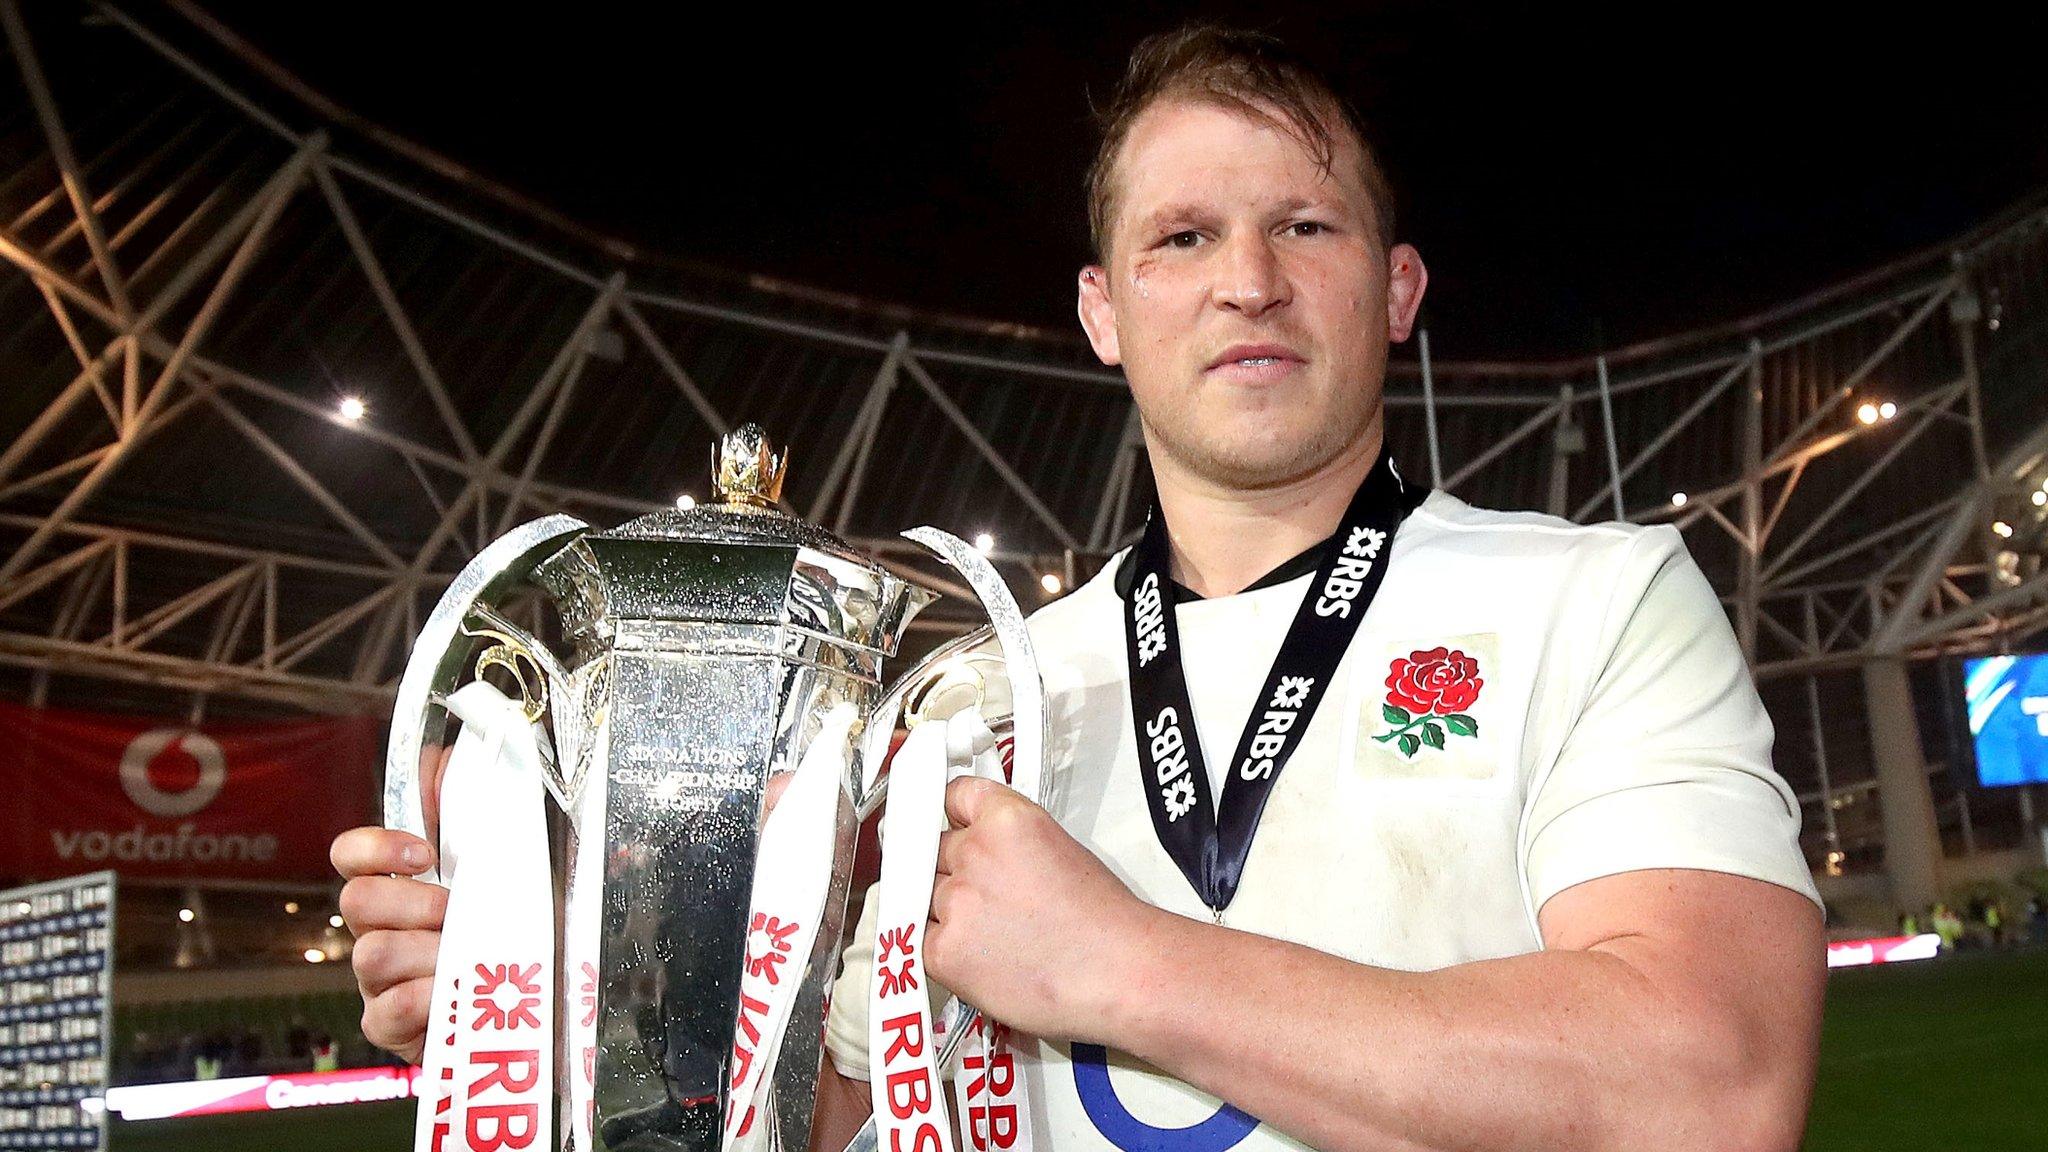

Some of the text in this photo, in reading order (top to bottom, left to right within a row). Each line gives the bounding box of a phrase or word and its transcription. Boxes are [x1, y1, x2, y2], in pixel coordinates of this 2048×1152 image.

[1133, 571, 1168, 638] RBS
[1315, 555, 1373, 619] RBS
[1146, 706, 1192, 785] RBS
[1240, 711, 1298, 780] RBS
[50, 825, 279, 862] vodafone
